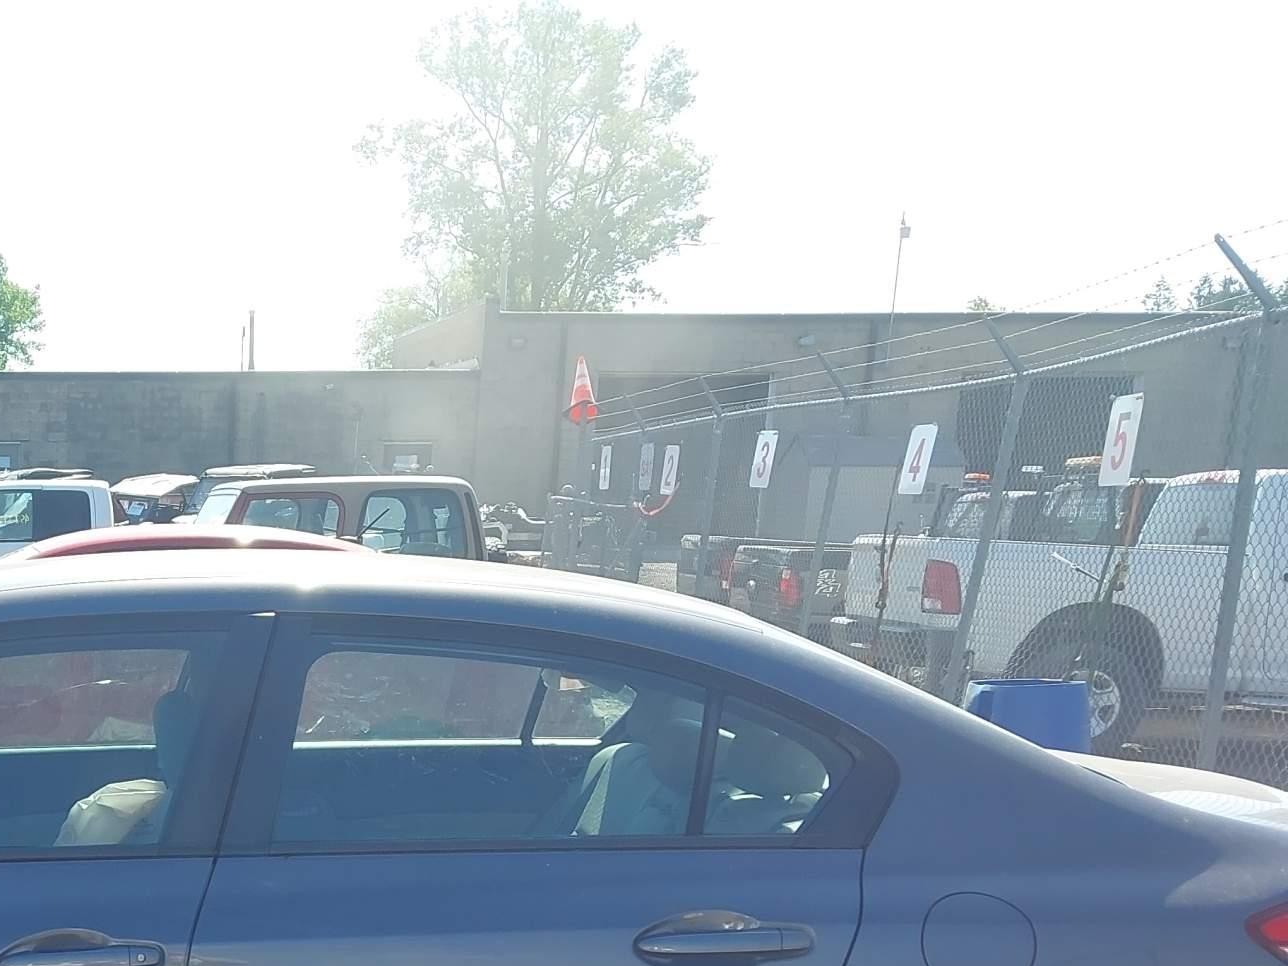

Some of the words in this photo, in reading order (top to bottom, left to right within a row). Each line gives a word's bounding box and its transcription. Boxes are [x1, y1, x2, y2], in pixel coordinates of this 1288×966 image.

[756, 441, 770, 479] 3
[908, 437, 926, 483] 4
[1110, 411, 1132, 471] 5
[663, 455, 675, 487] 2
